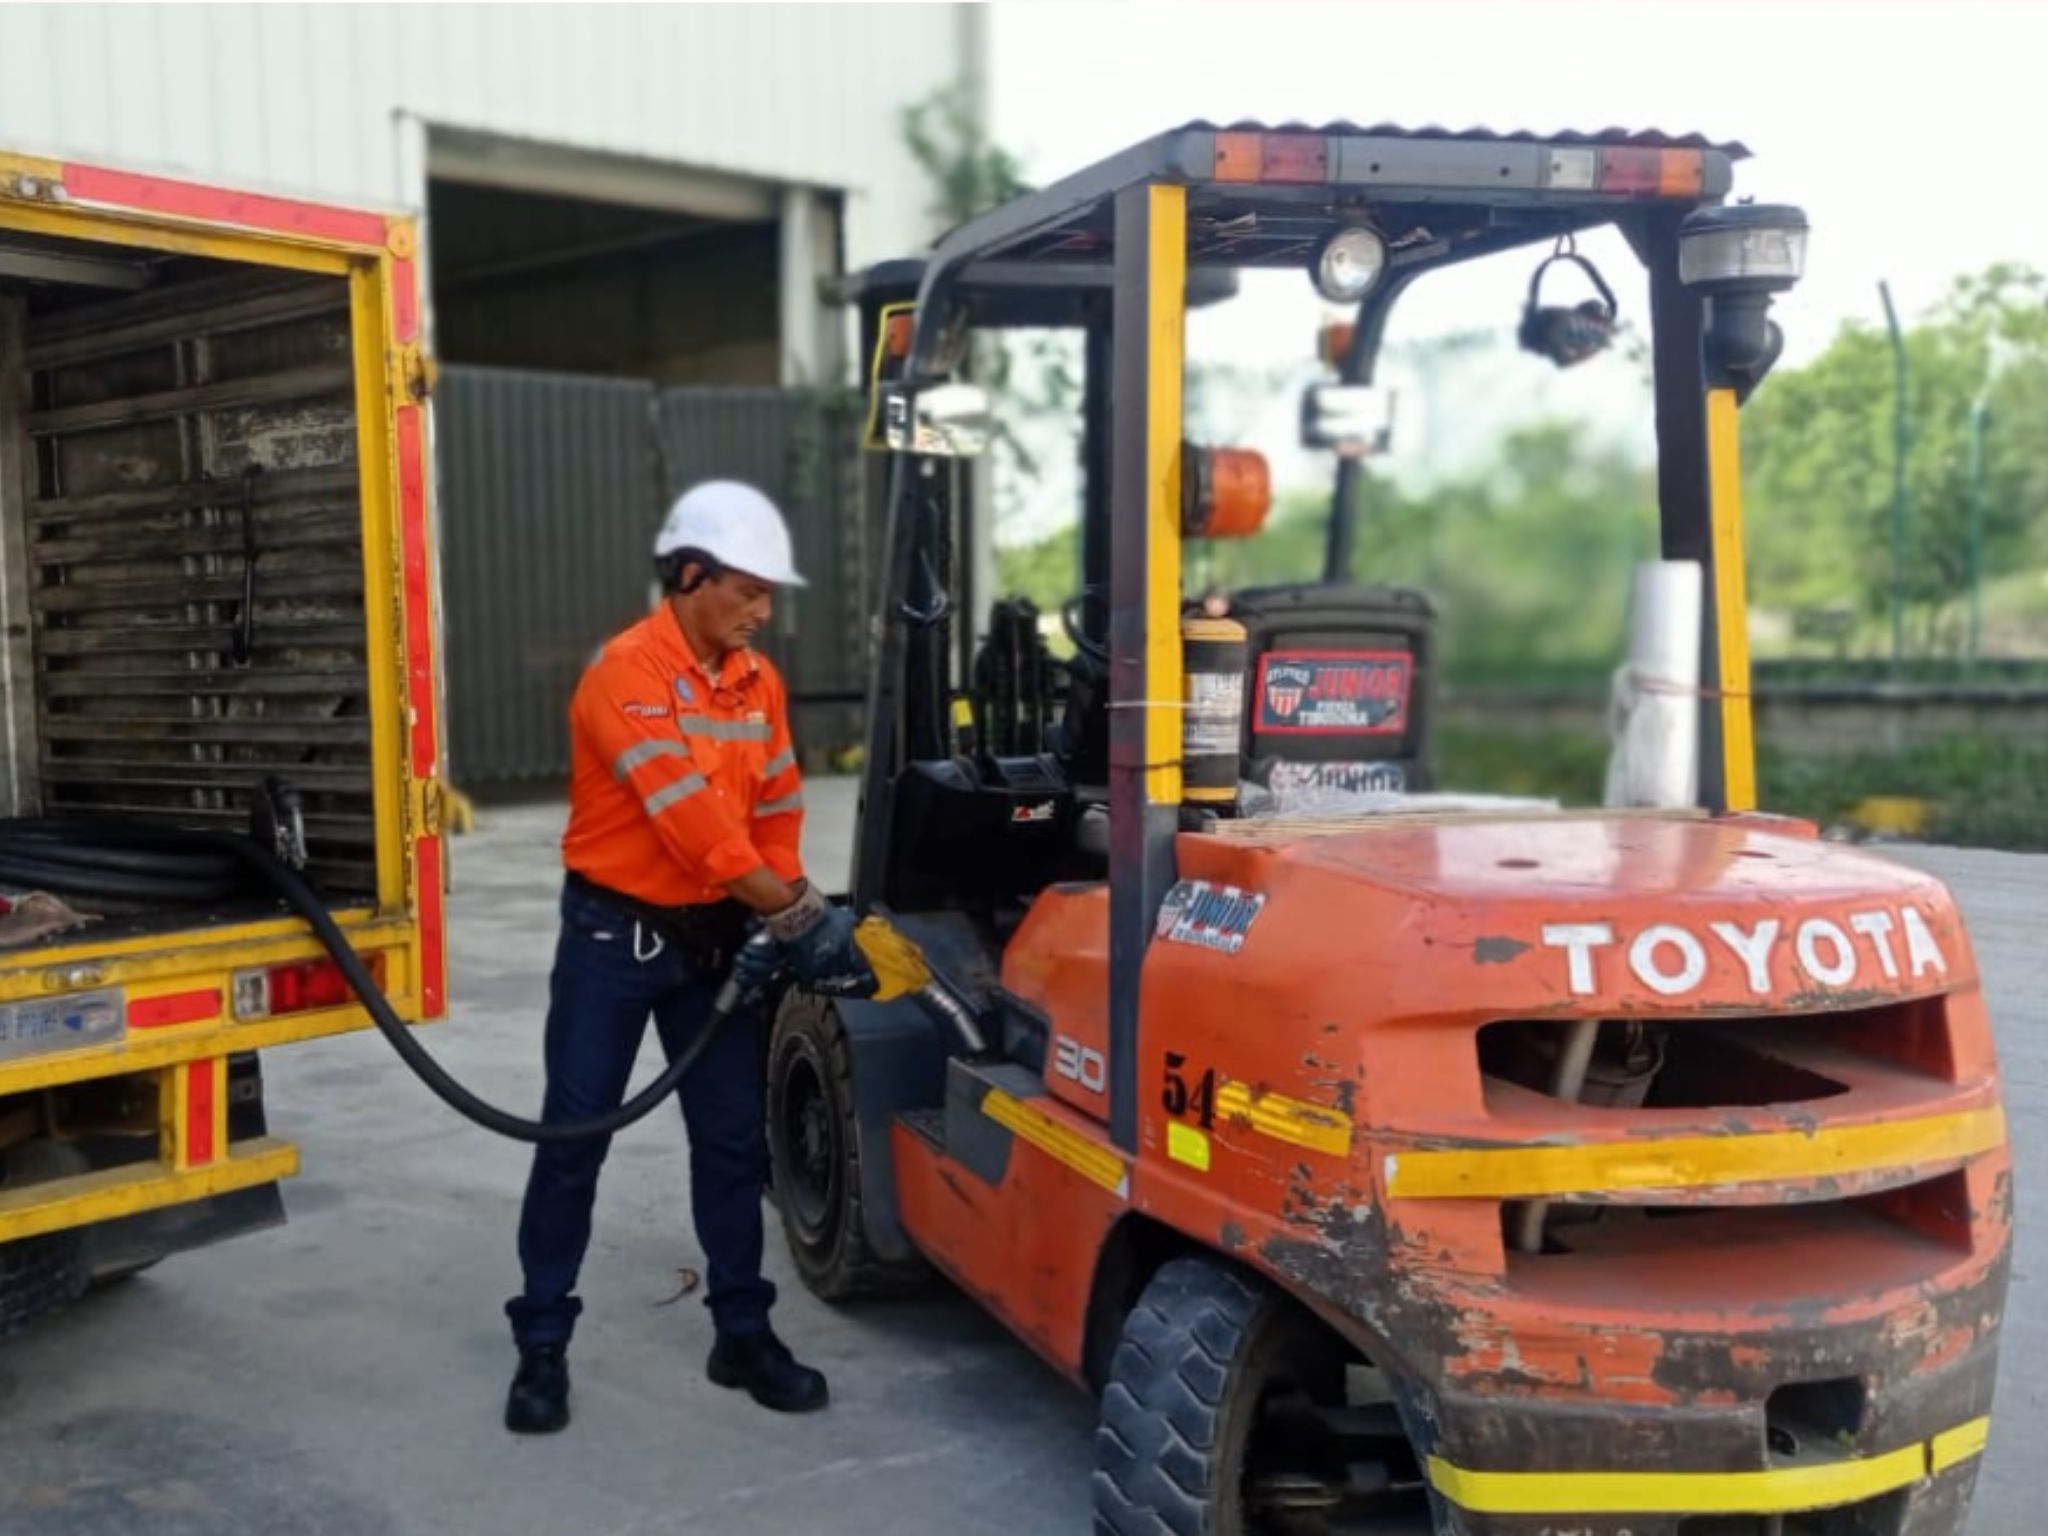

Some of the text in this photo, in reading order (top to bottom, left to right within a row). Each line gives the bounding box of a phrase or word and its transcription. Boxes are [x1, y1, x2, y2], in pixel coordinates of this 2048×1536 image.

[1308, 667, 1403, 699] JUNIOR
[1542, 905, 1949, 997] TOYOTA
[1054, 1033, 1106, 1094] 30
[1161, 1050, 1215, 1131] 54
